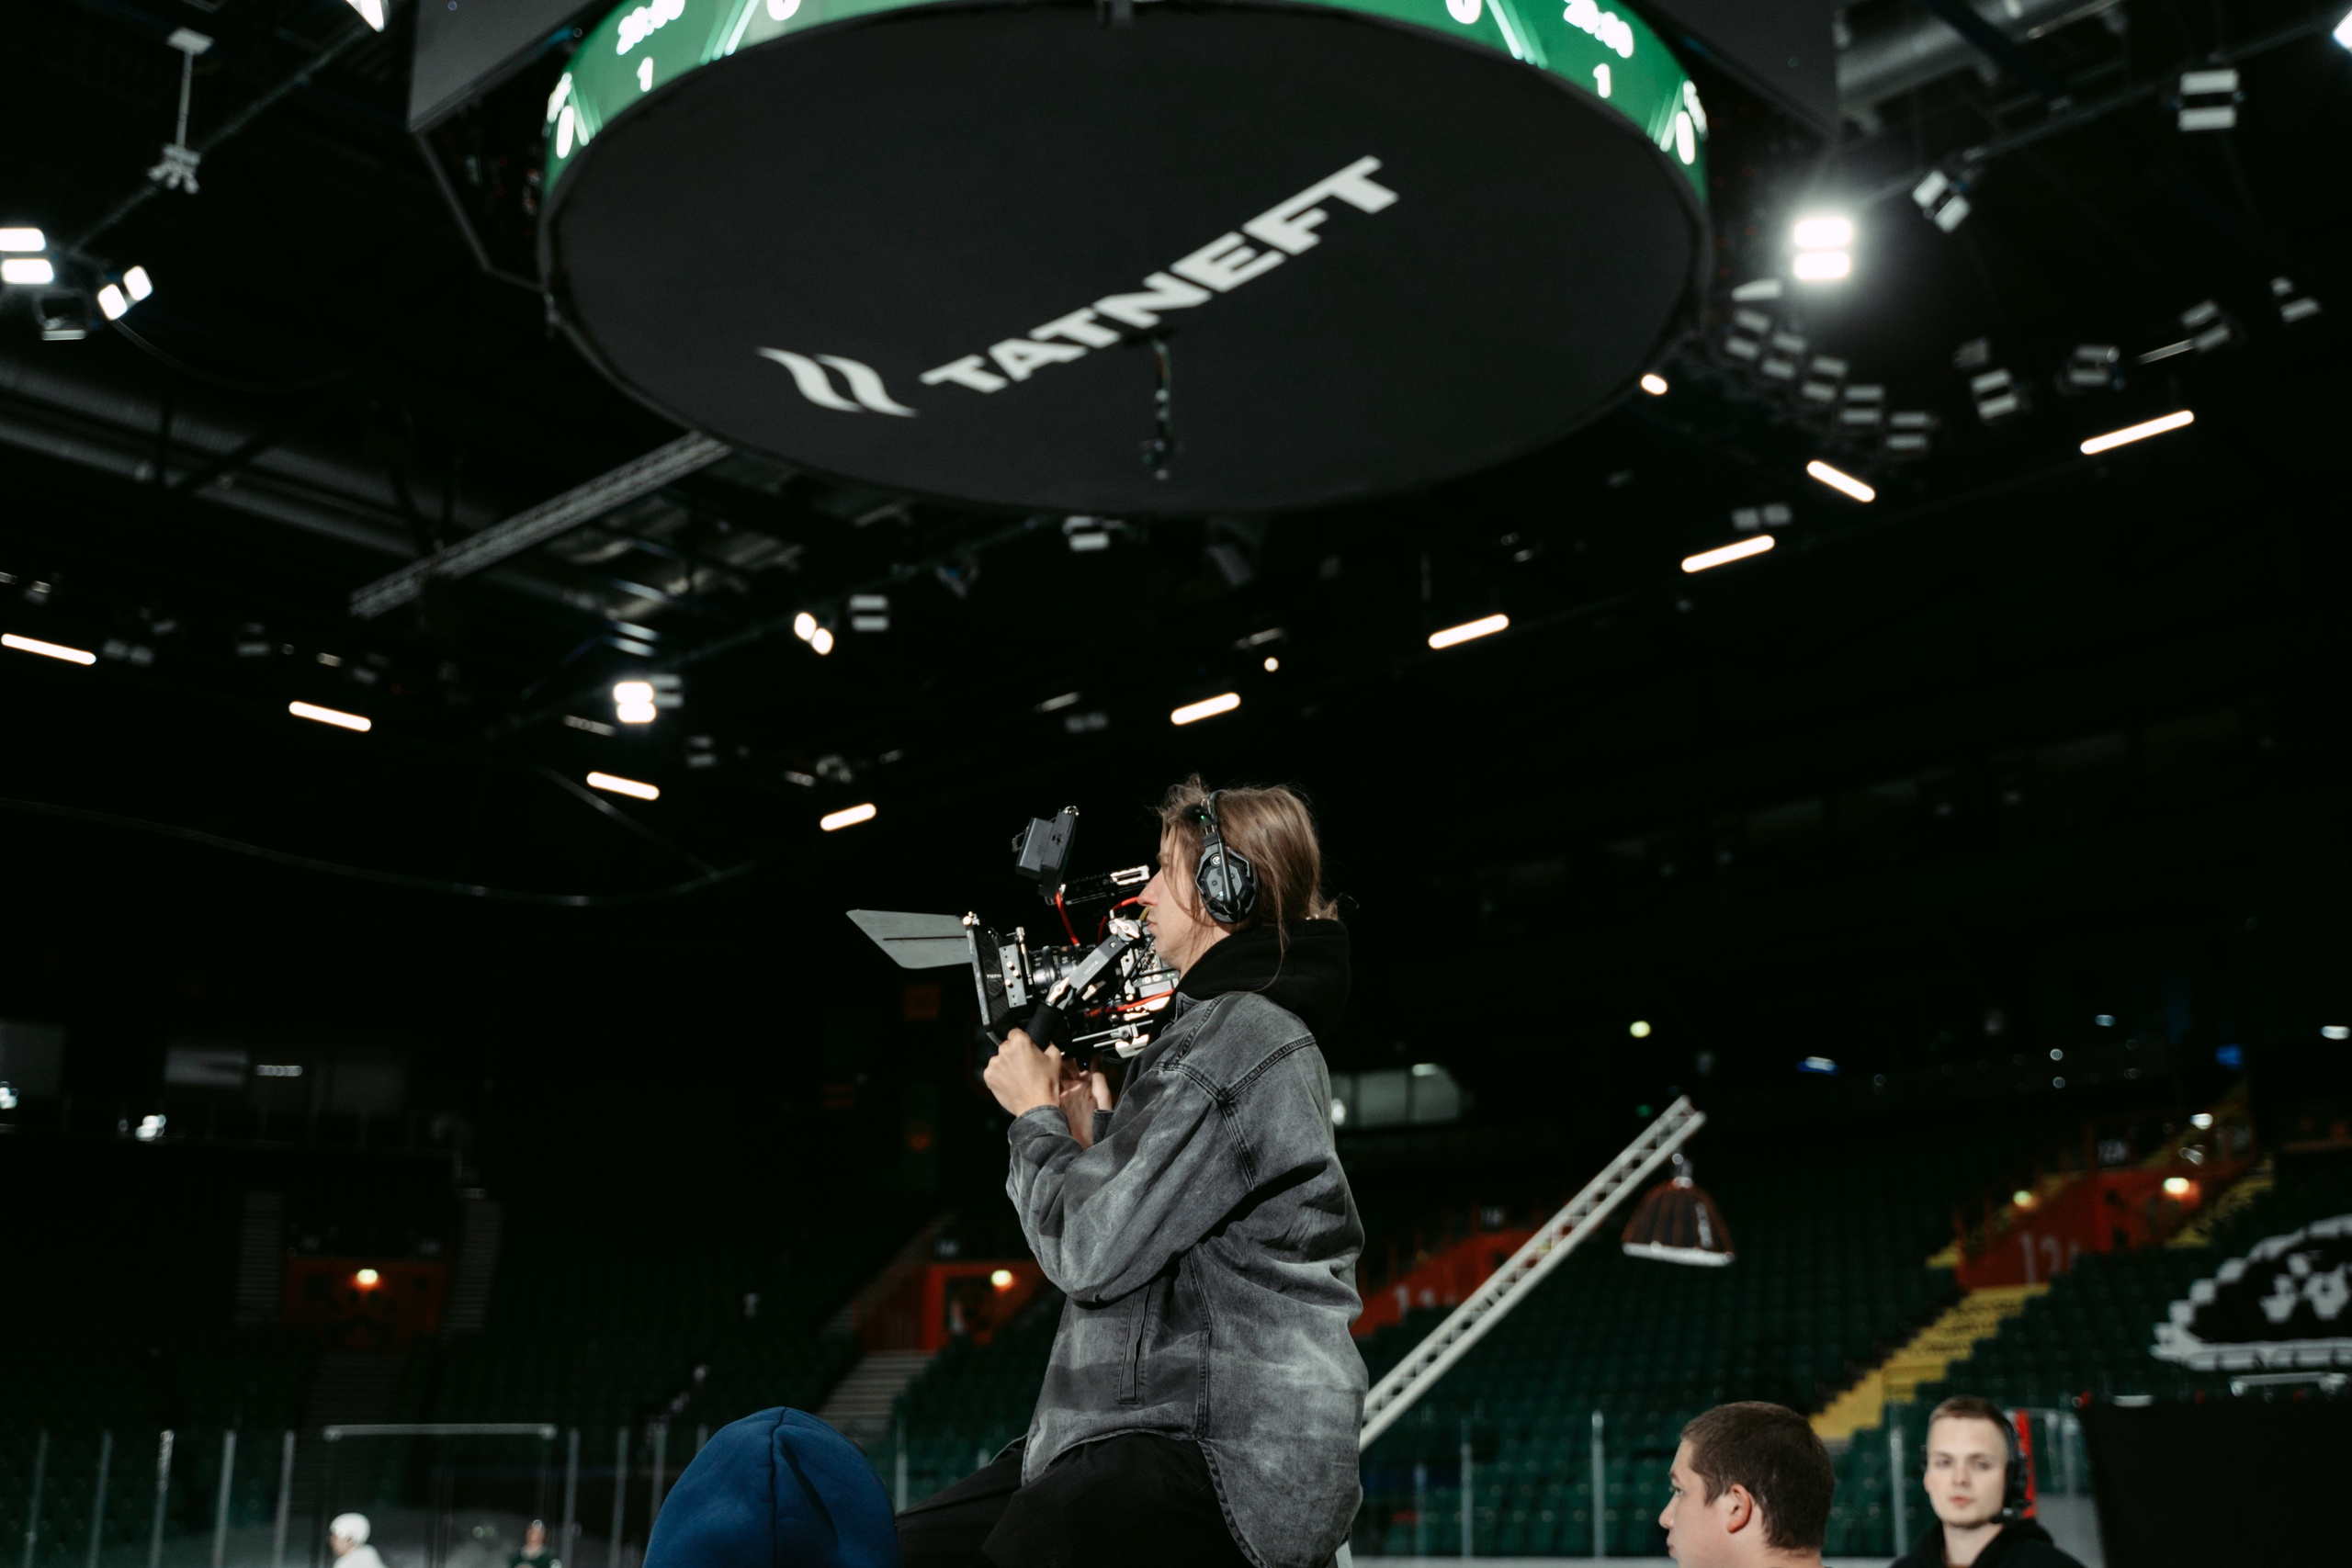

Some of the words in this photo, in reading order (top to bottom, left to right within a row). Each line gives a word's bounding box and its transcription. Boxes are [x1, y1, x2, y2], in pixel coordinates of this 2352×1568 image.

[637, 57, 653, 92] 1
[1593, 63, 1611, 98] 1
[921, 154, 1399, 395] TATNEFT
